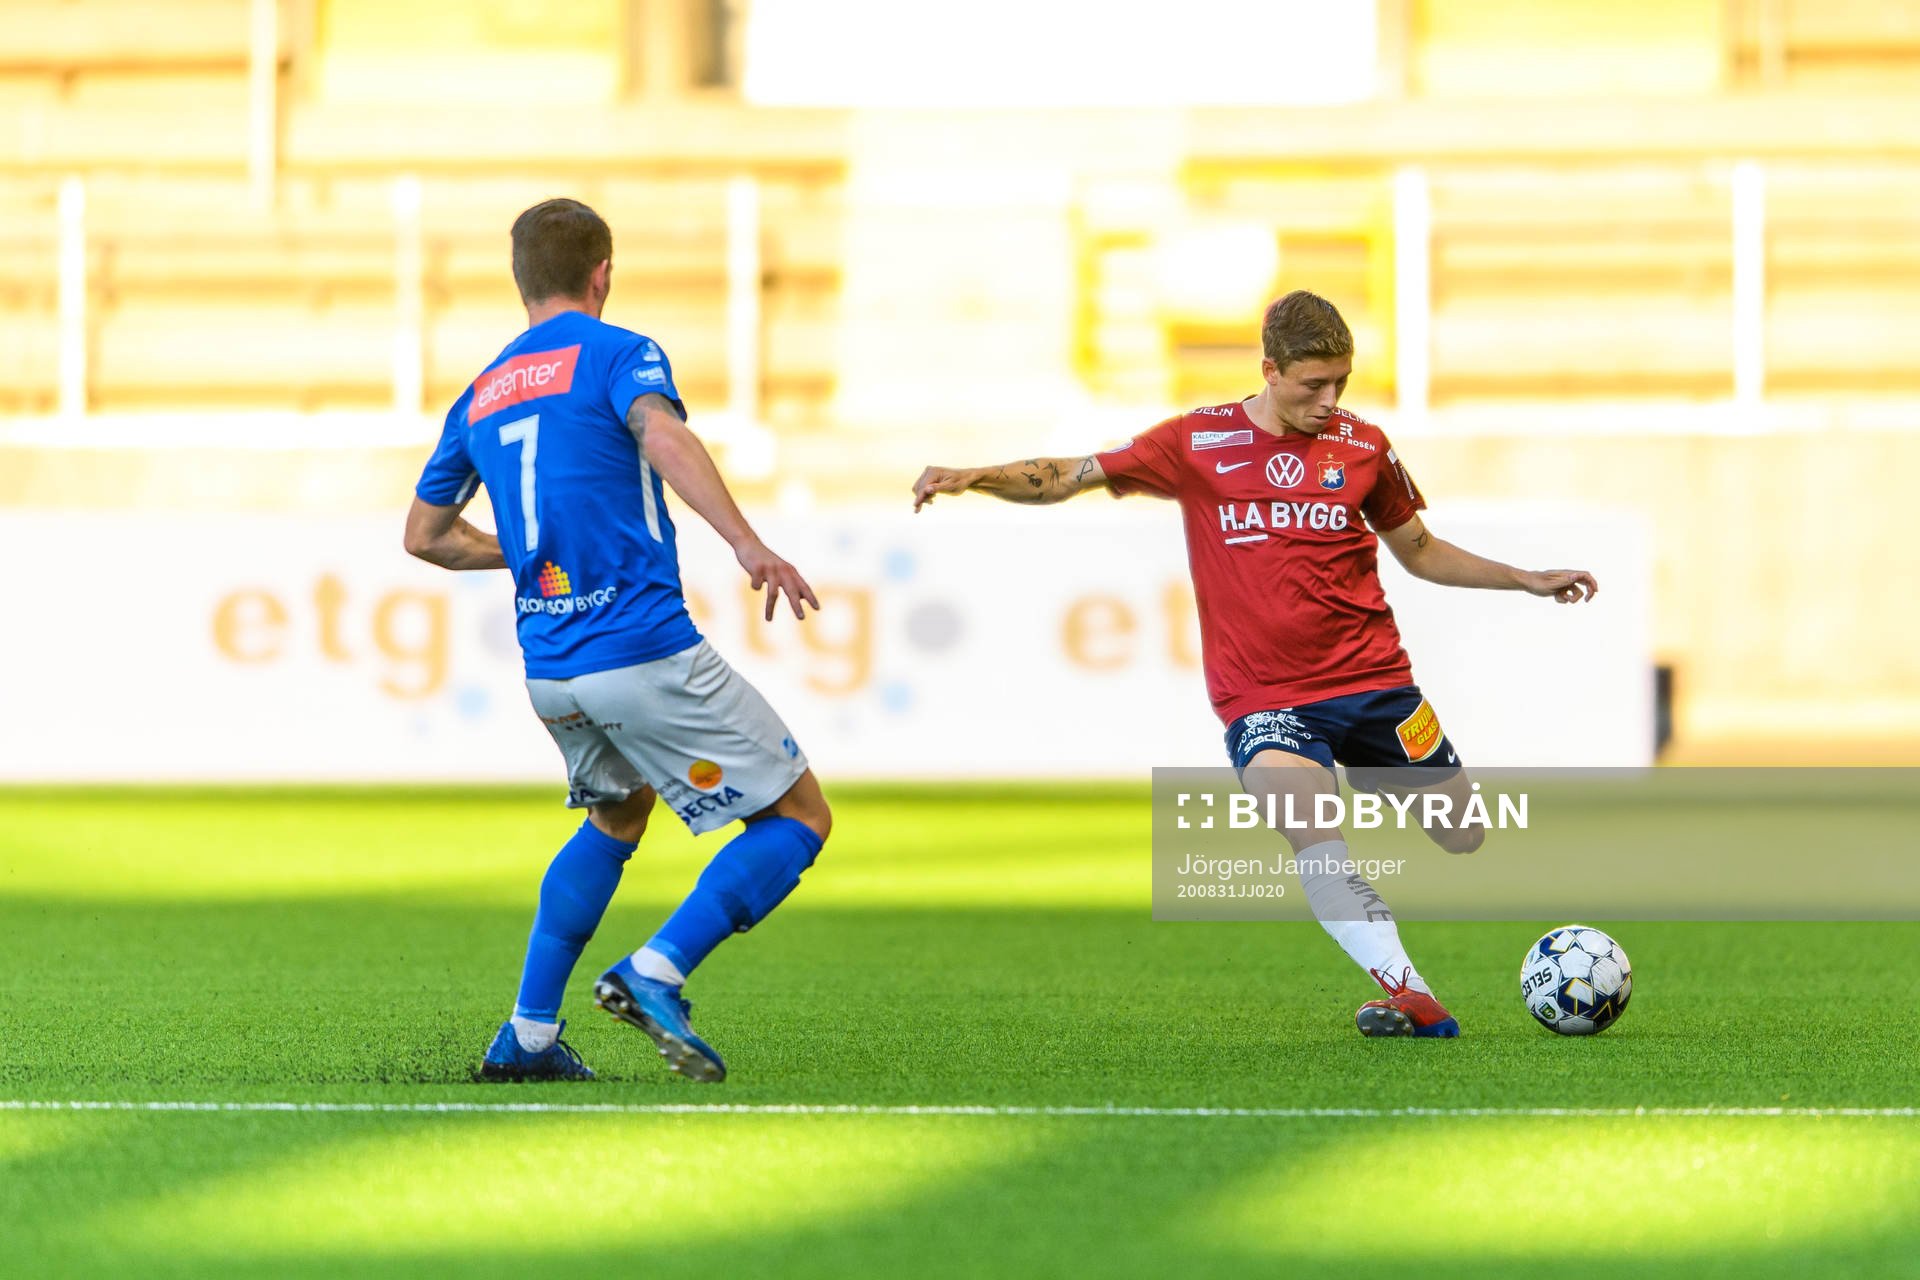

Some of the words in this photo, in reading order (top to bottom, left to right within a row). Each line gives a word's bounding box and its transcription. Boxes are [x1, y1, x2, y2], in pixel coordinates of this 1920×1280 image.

[478, 360, 562, 408] elcenter
[1317, 433, 1345, 443] ERNST
[1347, 438, 1376, 452] ROSÉN
[499, 413, 540, 552] 7
[1218, 502, 1266, 532] H.A
[1271, 502, 1347, 531] BYGG
[1243, 733, 1300, 756] stadium
